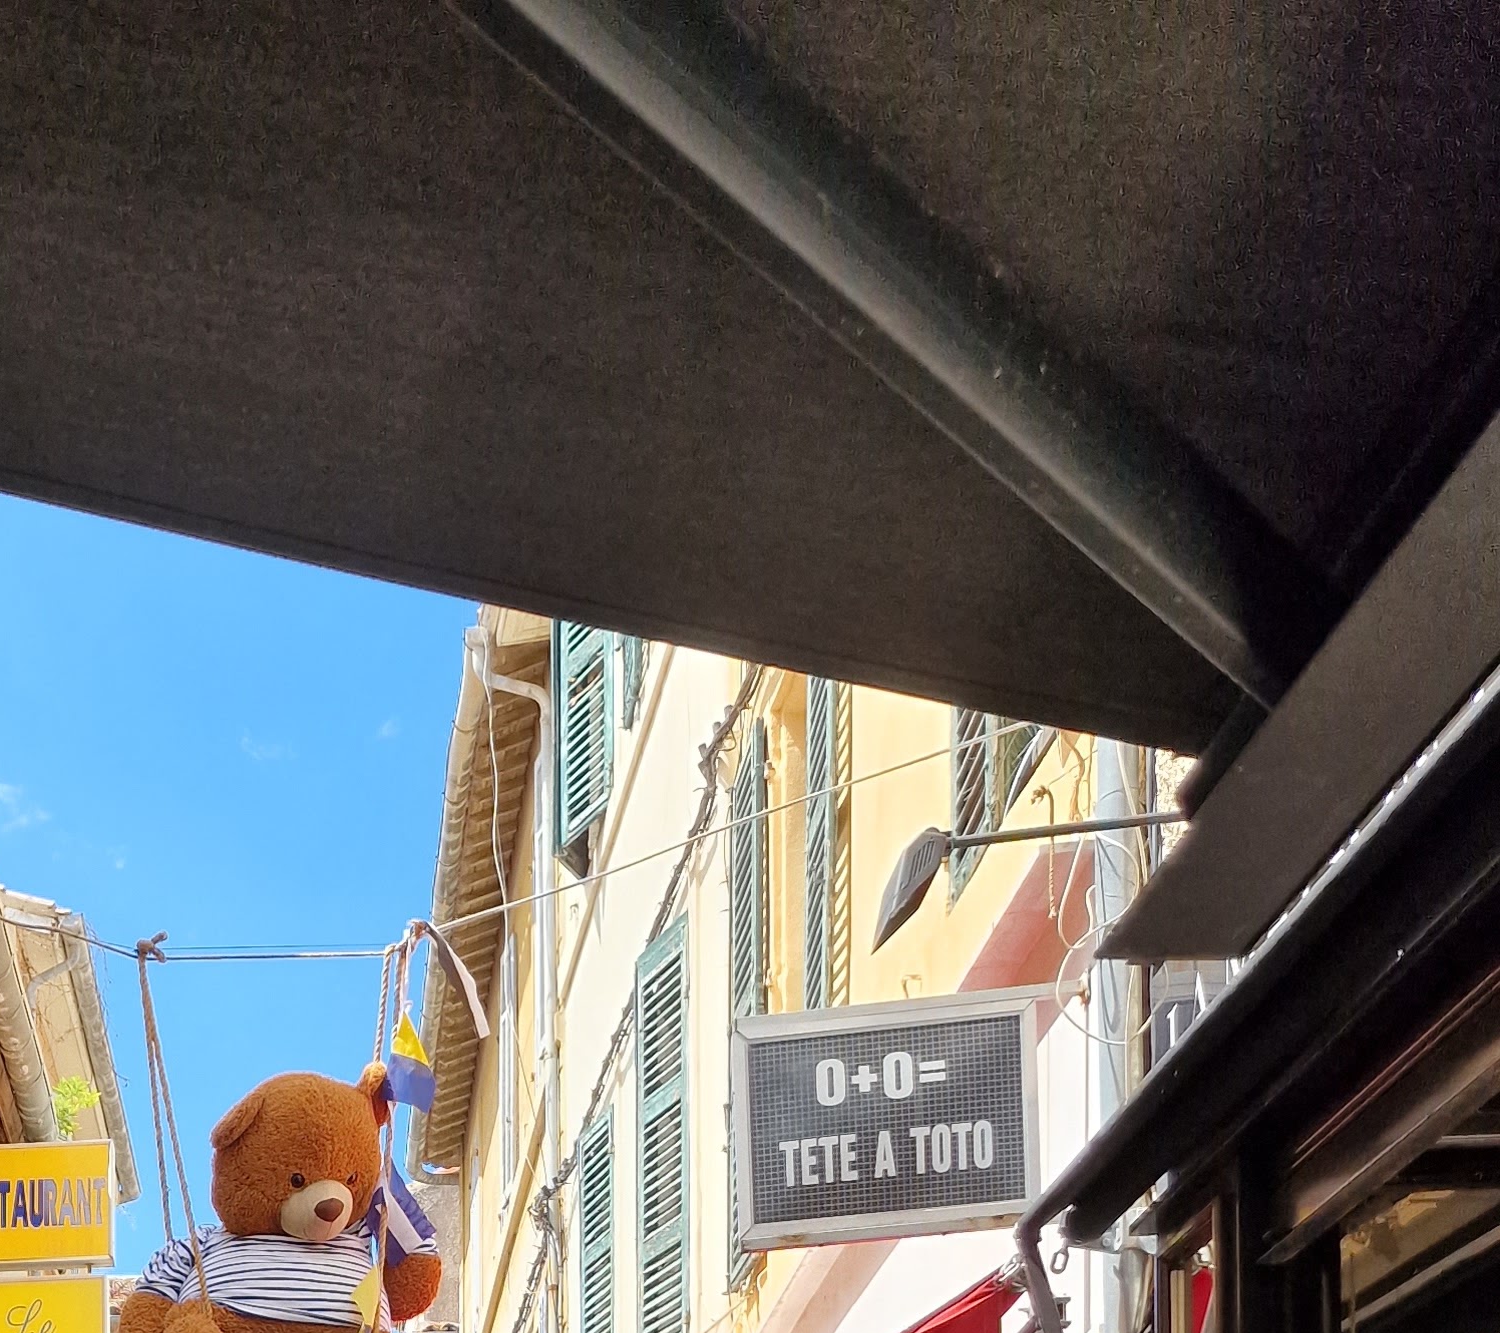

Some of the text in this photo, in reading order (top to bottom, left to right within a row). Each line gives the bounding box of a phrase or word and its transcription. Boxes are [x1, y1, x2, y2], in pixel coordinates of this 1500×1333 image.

[779, 1120, 994, 1188] TETE A TOTO
